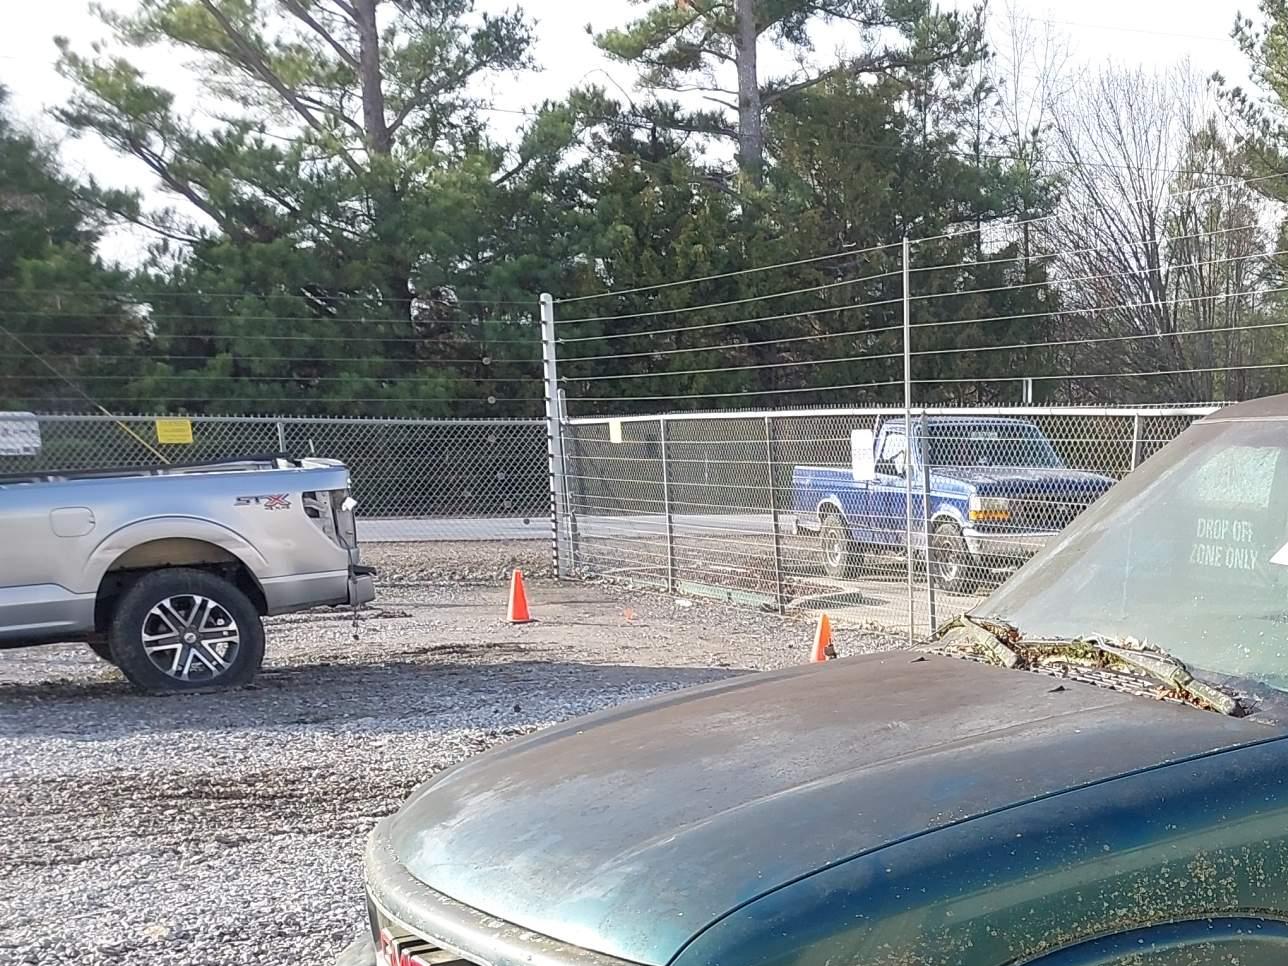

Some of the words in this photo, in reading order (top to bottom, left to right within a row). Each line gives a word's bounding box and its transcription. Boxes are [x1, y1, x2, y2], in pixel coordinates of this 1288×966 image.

[233, 493, 291, 506] STX
[1196, 518, 1228, 540] DROP
[1232, 520, 1254, 542] OFF
[1190, 543, 1223, 567] ZONE
[1225, 547, 1258, 570] ONLY
